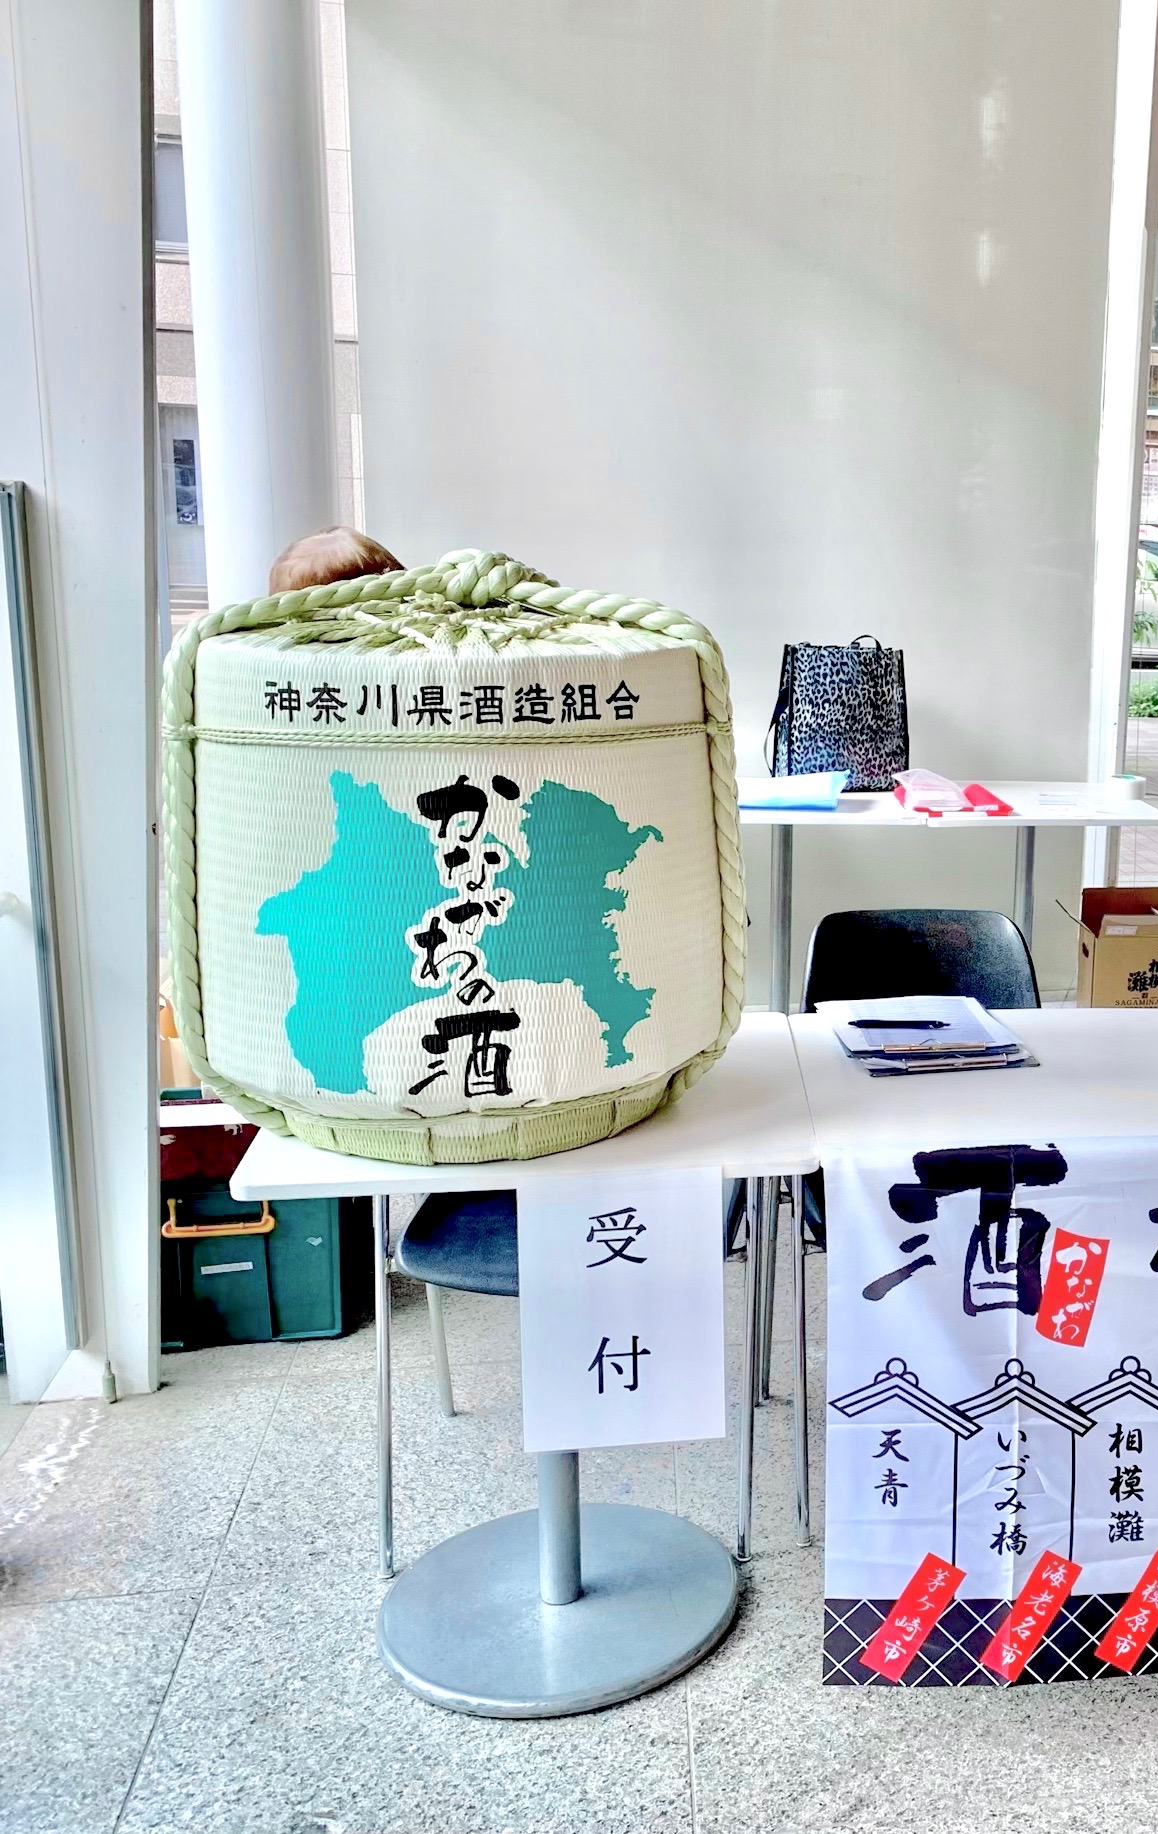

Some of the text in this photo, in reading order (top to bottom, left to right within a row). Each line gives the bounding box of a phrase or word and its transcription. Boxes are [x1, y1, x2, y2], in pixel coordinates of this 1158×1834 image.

[264, 680, 641, 726] 神奈川県酒造組合
[409, 773, 521, 1097] かながわの酒
[862, 1142, 1069, 1318] 酒
[1051, 1241, 1103, 1340] かながわ
[584, 1206, 652, 1395] 受付
[872, 1428, 910, 1509] 天青
[989, 1429, 1029, 1556] いづみ橋
[1107, 1422, 1145, 1544] 相模灘
[998, 1559, 1069, 1667] 海老名市
